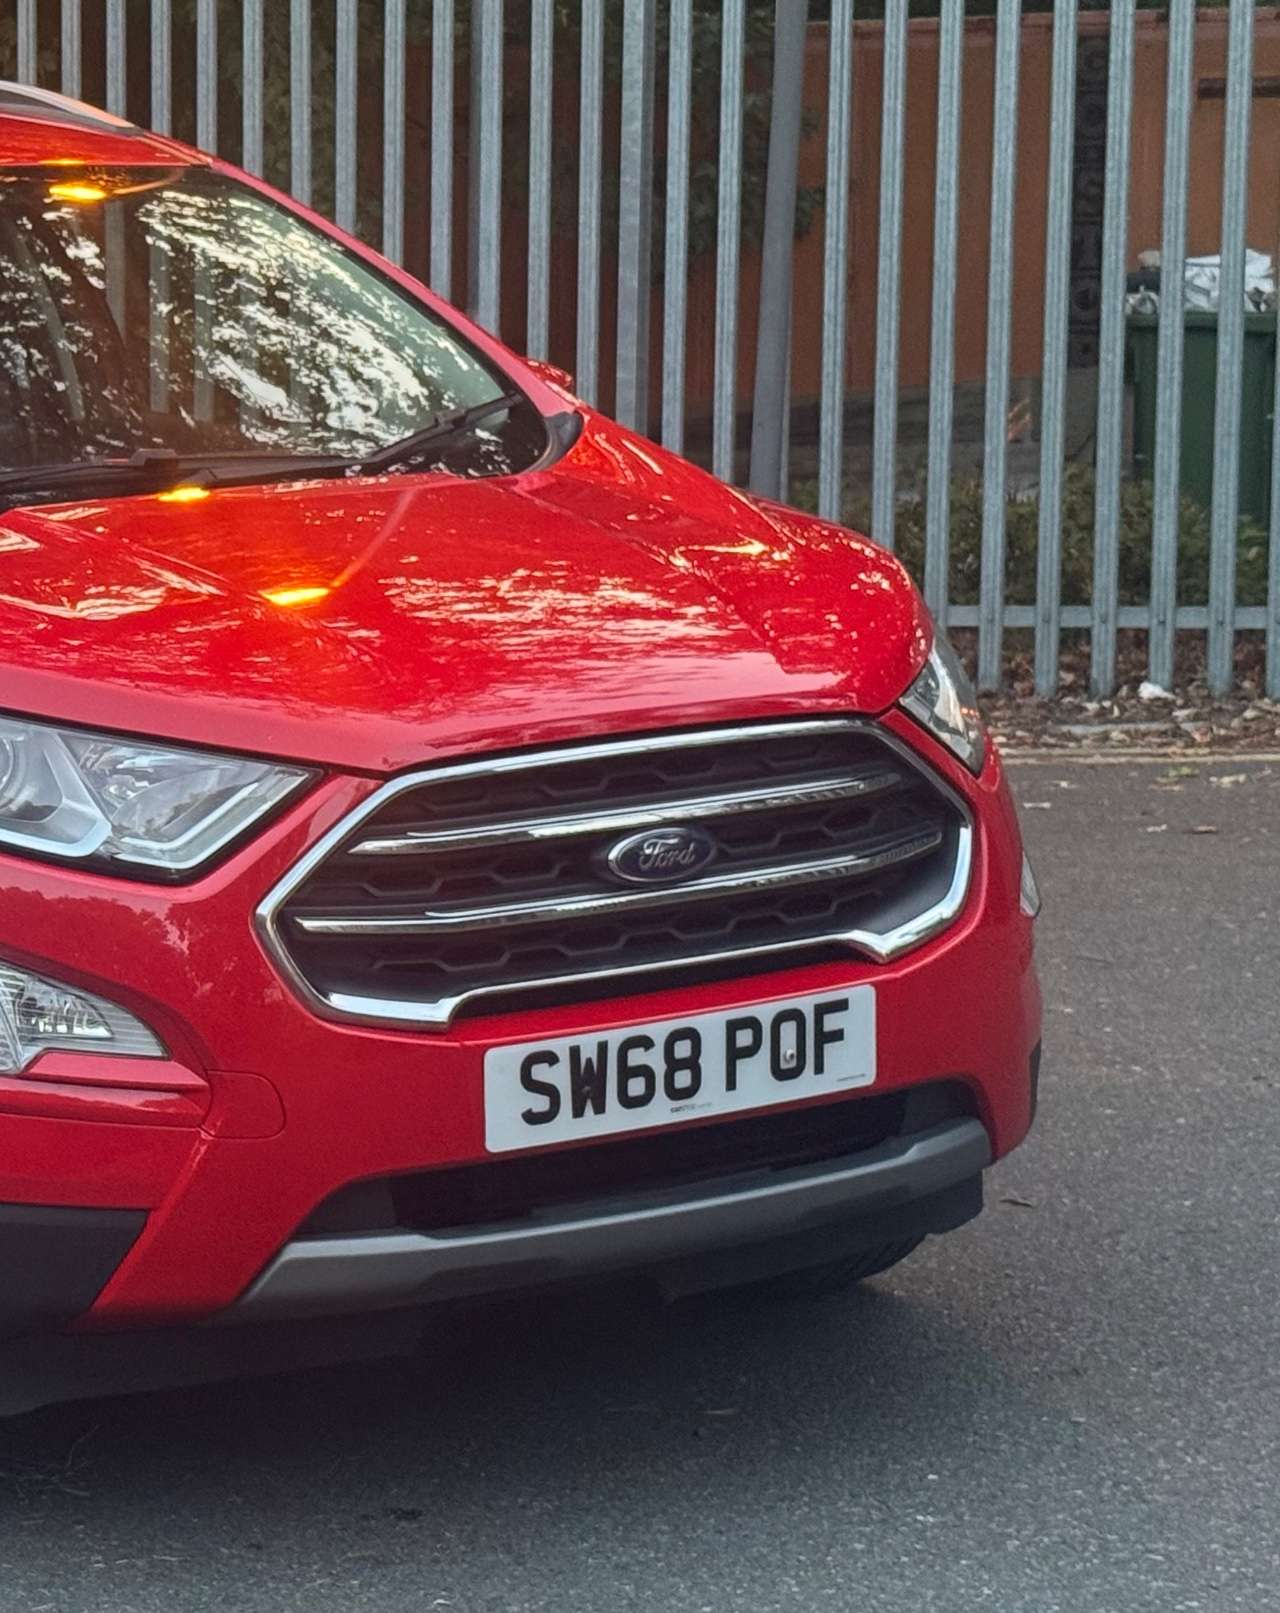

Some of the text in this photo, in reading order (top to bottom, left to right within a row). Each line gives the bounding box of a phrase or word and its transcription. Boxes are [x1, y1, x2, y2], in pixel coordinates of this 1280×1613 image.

[639, 837, 696, 870] Ford
[520, 997, 850, 1126] SW68 POF
